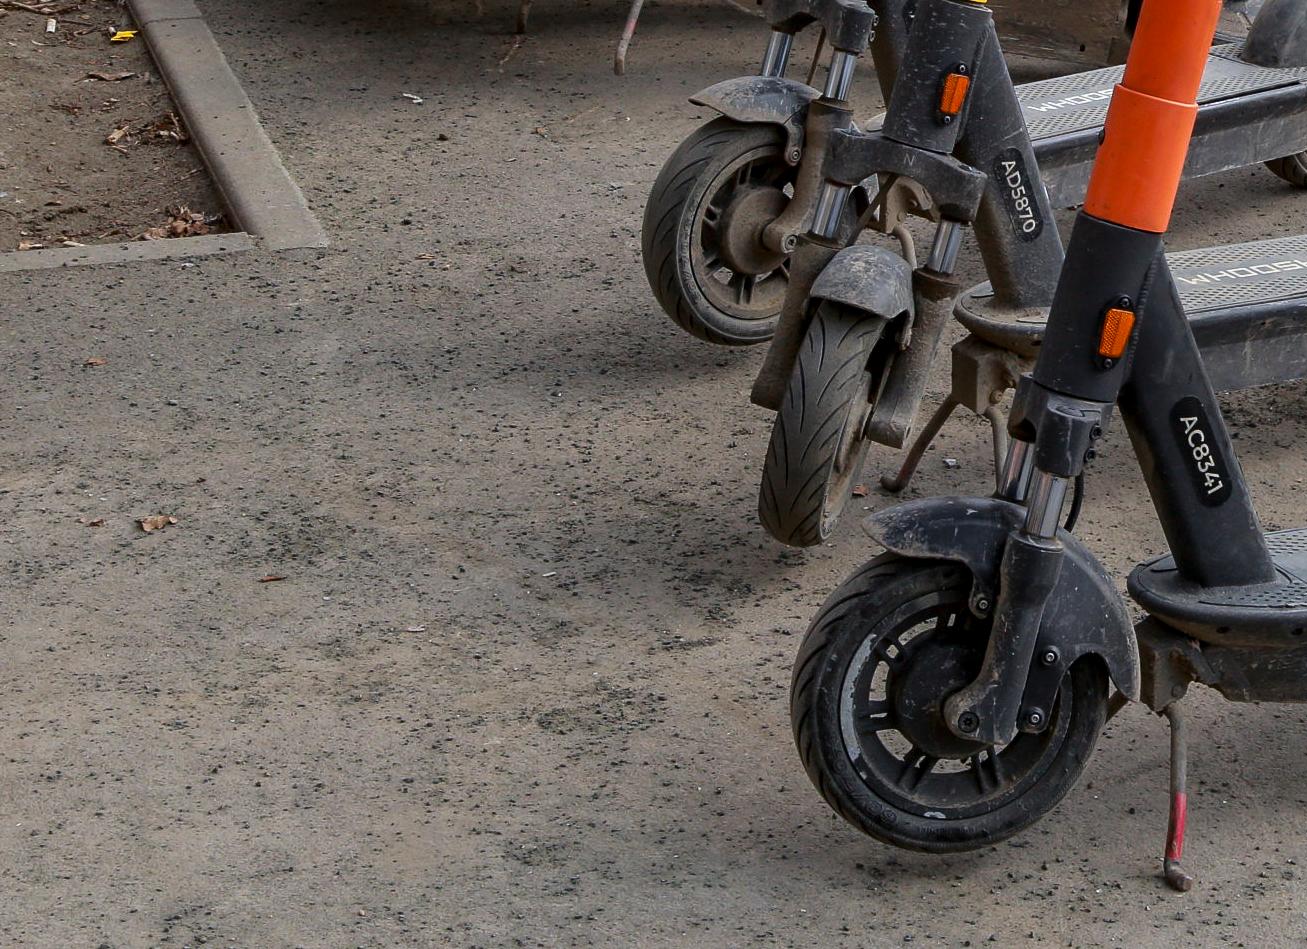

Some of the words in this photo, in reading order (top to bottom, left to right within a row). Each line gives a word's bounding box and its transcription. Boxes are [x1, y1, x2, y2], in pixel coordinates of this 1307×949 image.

[1027, 88, 1113, 112] WHOO
[1001, 161, 1036, 232] AD5870
[1180, 416, 1223, 495] AC8341
